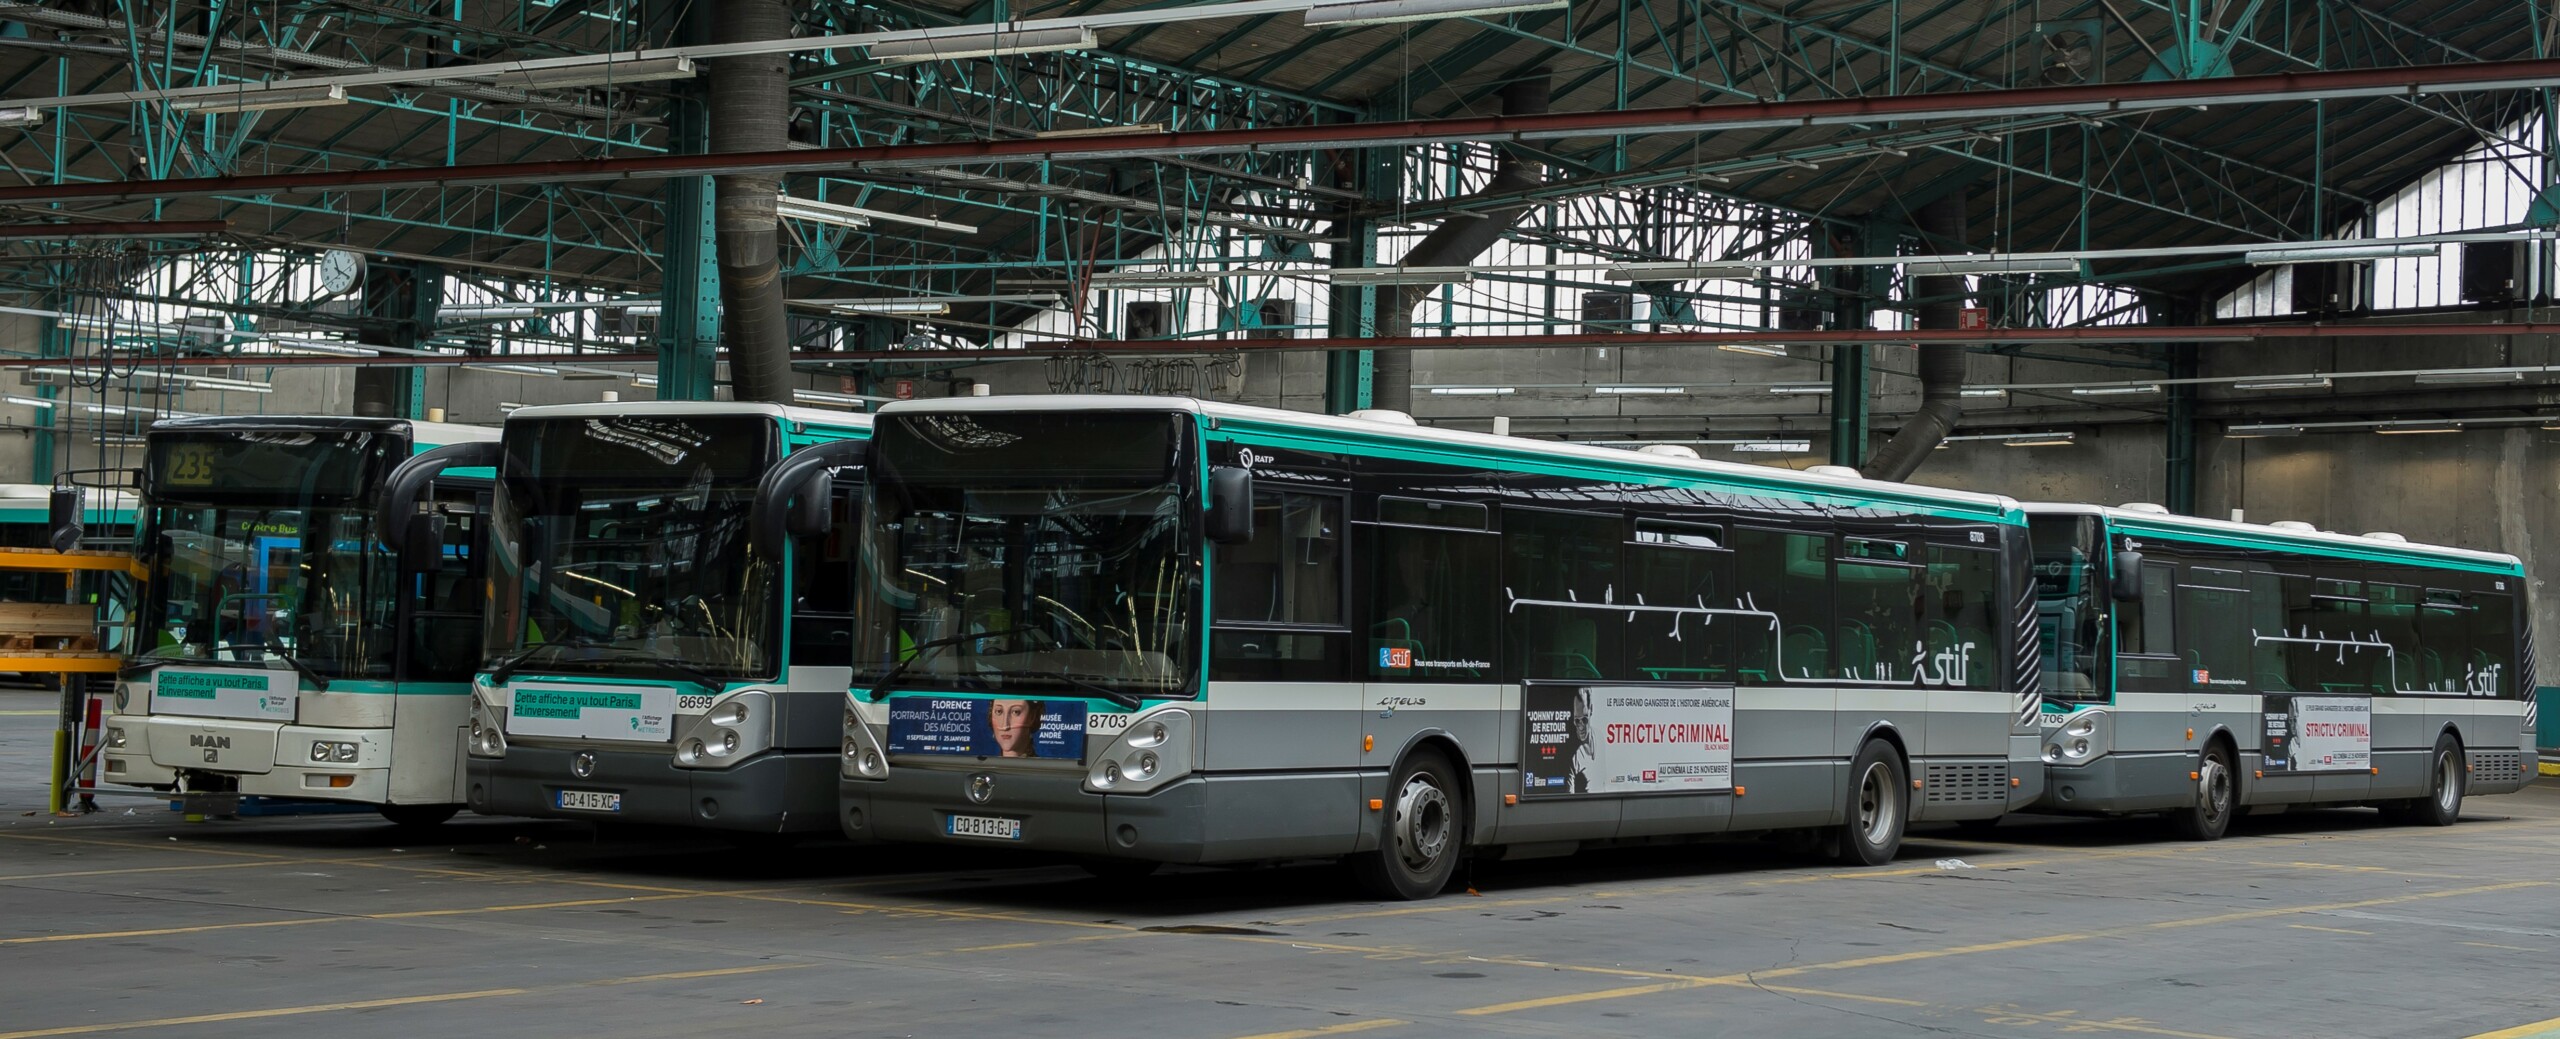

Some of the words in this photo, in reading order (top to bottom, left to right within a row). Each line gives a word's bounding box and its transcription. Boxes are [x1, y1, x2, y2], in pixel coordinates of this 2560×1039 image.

[1254, 455, 1275, 464] RATP
[173, 451, 213, 480] 235
[279, 523, 298, 534] Bus
[1414, 659, 1425, 667] Tous
[1434, 660, 1456, 668] transports
[158, 673, 177, 685] Cette
[178, 675, 205, 687] affiche
[205, 679, 211, 687] a
[212, 679, 222, 687] vu
[224, 678, 240, 688] tout
[241, 678, 264, 690] Paris.
[157, 685, 166, 696] Et
[166, 686, 217, 699] inversement.
[514, 691, 538, 704] Cette
[538, 693, 568, 705] affiche
[569, 696, 575, 705] a
[577, 696, 588, 706] vu
[589, 695, 607, 706] tout
[609, 695, 636, 708] Paris.
[679, 695, 713, 709] 8699
[931, 700, 972, 710] FLORENCE
[1607, 698, 1612, 707] LE
[1613, 698, 1625, 707] PLUS
[1625, 698, 1643, 707] GRAND
[1644, 698, 1669, 708] GANGSTER
[1670, 698, 1677, 707] DE
[514, 704, 523, 715] Et
[524, 705, 580, 718] inversement.
[890, 710, 930, 720] PORTRAITS
[930, 709, 937, 721] À
[937, 711, 948, 721] LA
[948, 711, 972, 721] COUR
[1555, 711, 1572, 721] DEPP
[1039, 712, 1063, 722] MUSÉE
[1089, 714, 1128, 729] 8703
[2040, 714, 2064, 724] 706
[923, 722, 939, 732] DES
[939, 721, 971, 733] MÉDICIS
[1039, 722, 1083, 731] JACQUEMART
[1532, 722, 1541, 733] DE
[1541, 722, 1567, 733] RETOUR
[2306, 723, 2337, 737] STRICTLY
[2337, 723, 2369, 737] CRIMINAL
[911, 734, 938, 742] SEPTEMBRE
[1039, 730, 1062, 739] ANDRÉ
[1530, 734, 1539, 744] AU
[1606, 723, 1666, 744] STRICTLY
[1668, 723, 1729, 744] CRIMINAL
[190, 734, 231, 749] MAN
[1659, 766, 1667, 775] AU
[1667, 763, 1686, 775] CINÉMA
[1686, 765, 1693, 774] LE
[1694, 765, 1700, 774] 25
[1700, 765, 1728, 774] NOVEMBRE
